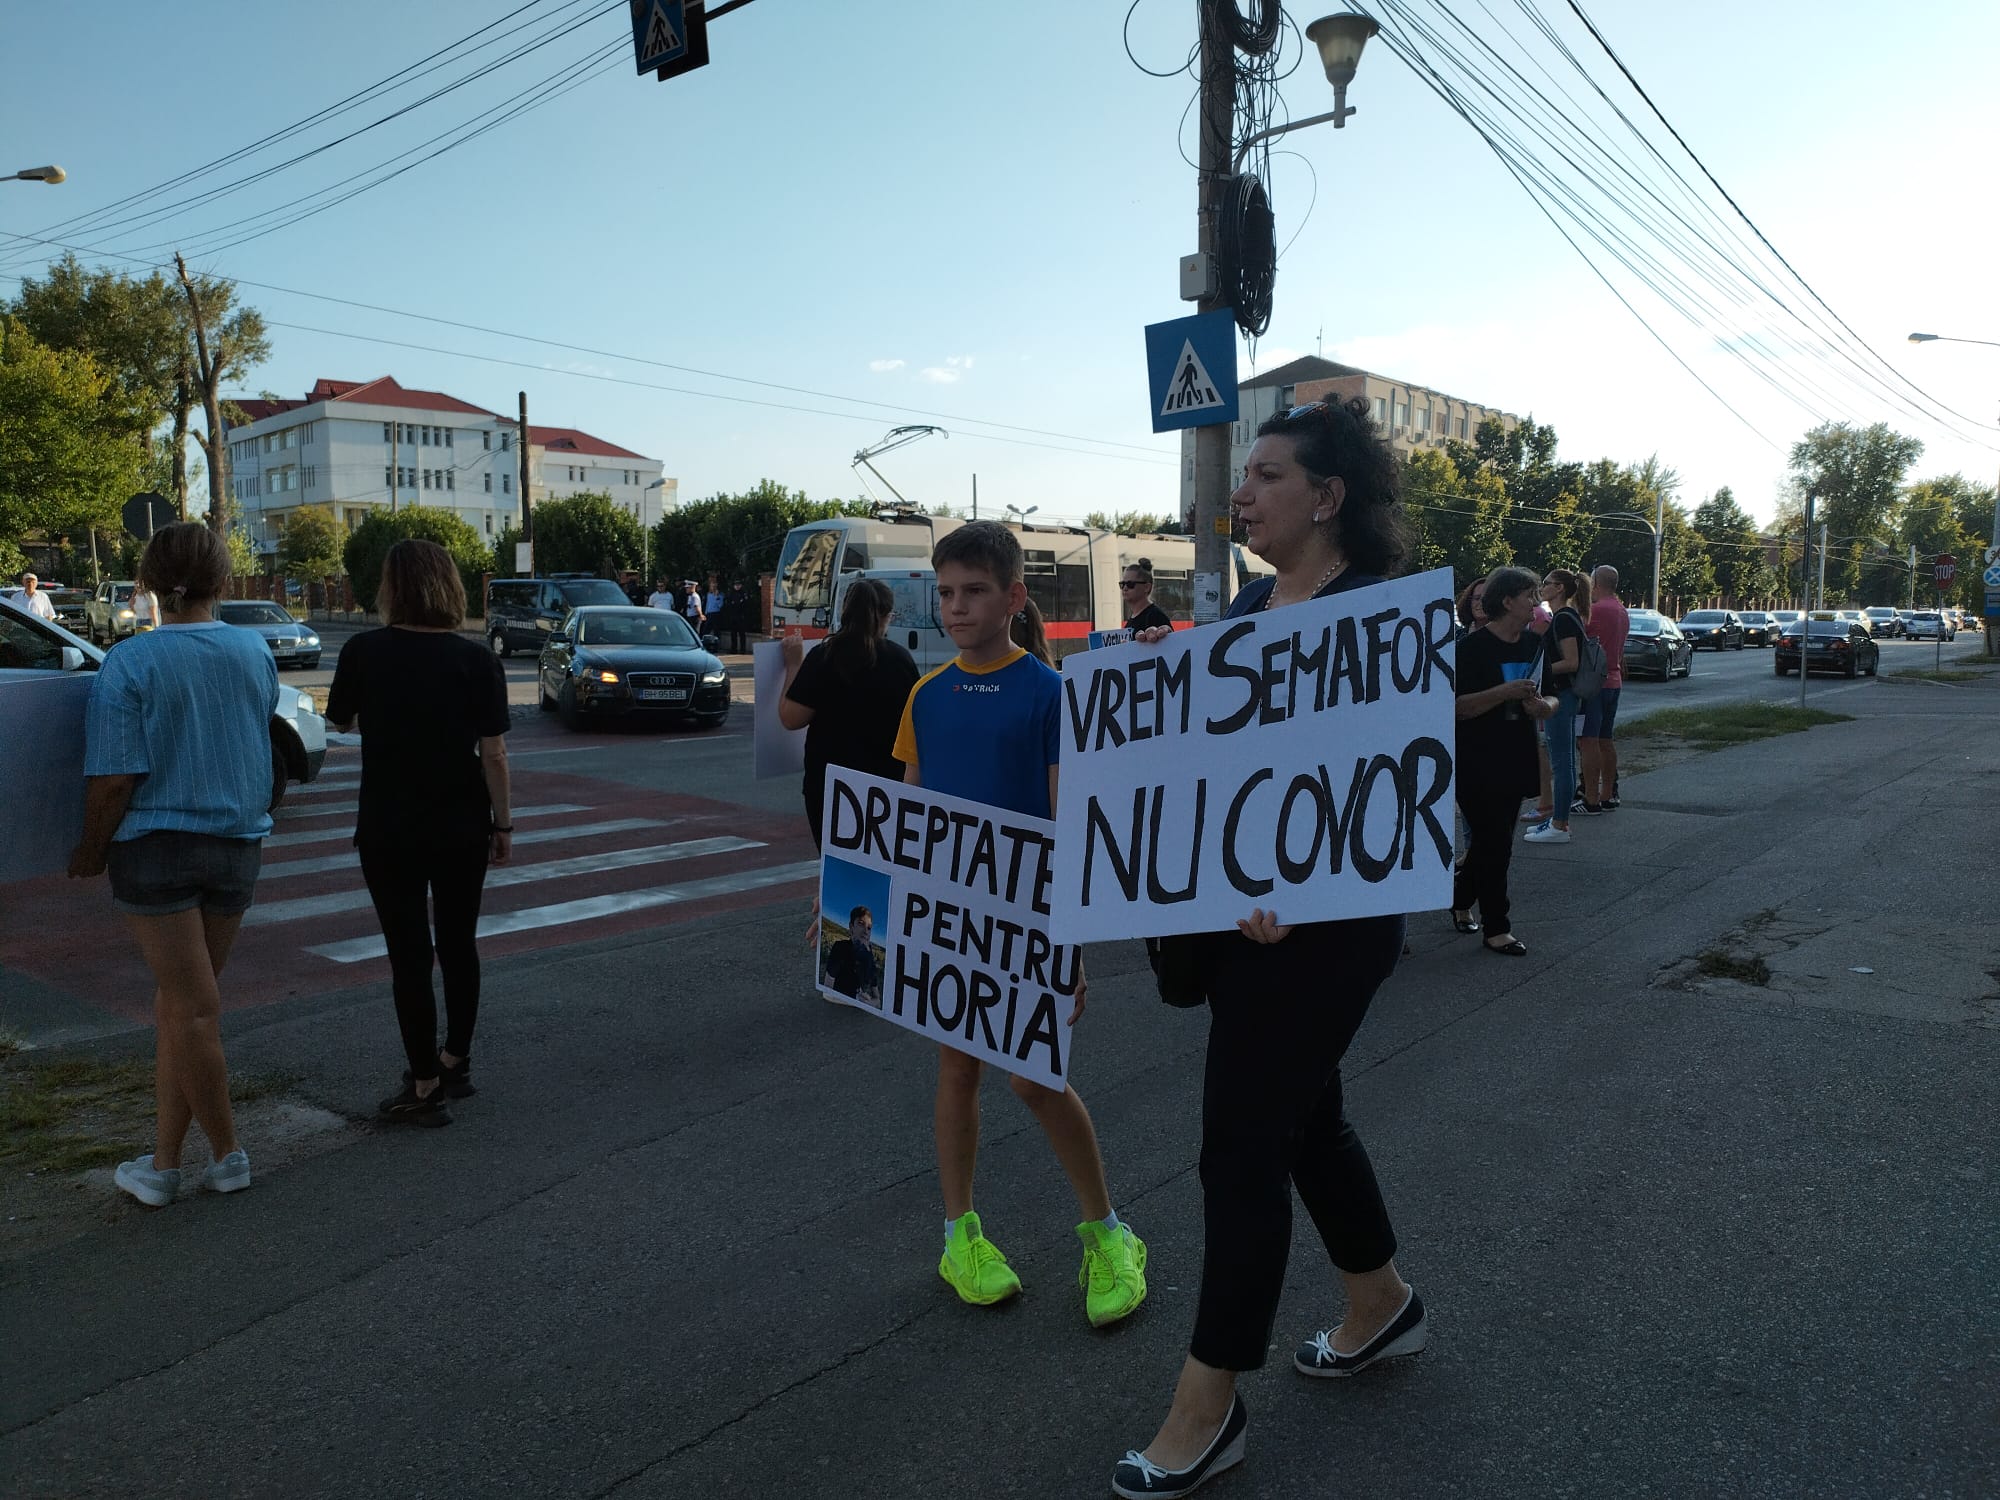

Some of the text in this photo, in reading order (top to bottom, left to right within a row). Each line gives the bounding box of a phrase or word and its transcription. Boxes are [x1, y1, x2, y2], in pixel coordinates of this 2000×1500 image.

[1935, 564, 1954, 580] STOP
[962, 684, 1000, 692] PATRICK
[1065, 598, 1455, 752] VREM SEMAFOR
[830, 779, 1056, 916] DREPTATE
[1081, 737, 1453, 906] NU COVOR
[903, 892, 1082, 996] PENTRU
